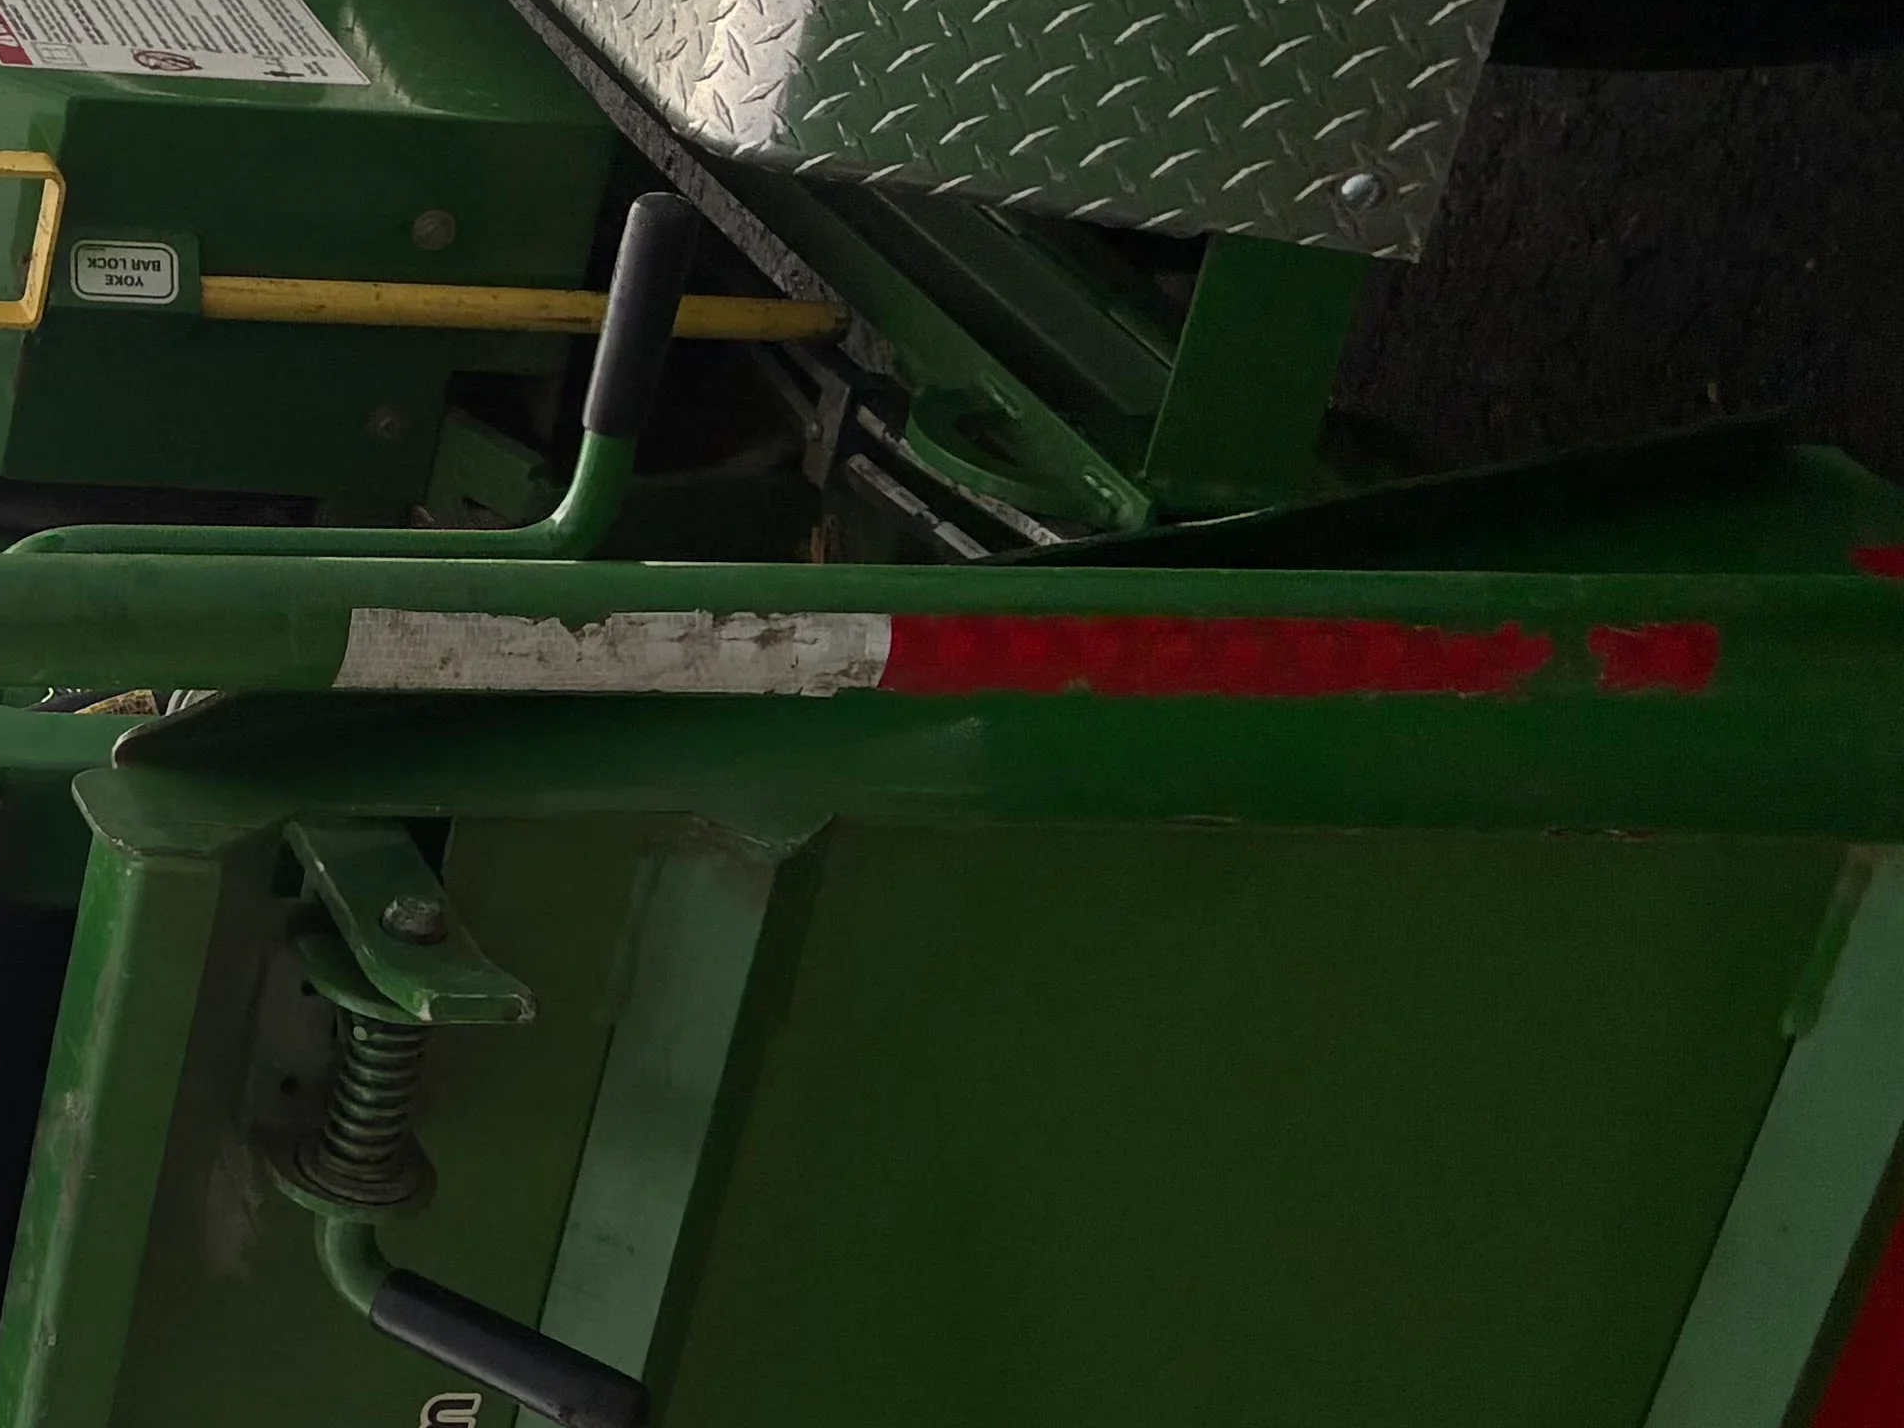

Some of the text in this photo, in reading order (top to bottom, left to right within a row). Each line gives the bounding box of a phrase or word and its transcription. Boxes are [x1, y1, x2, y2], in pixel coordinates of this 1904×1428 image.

[87, 257, 161, 272] BAR LOCK
[104, 274, 144, 287] YOKE
